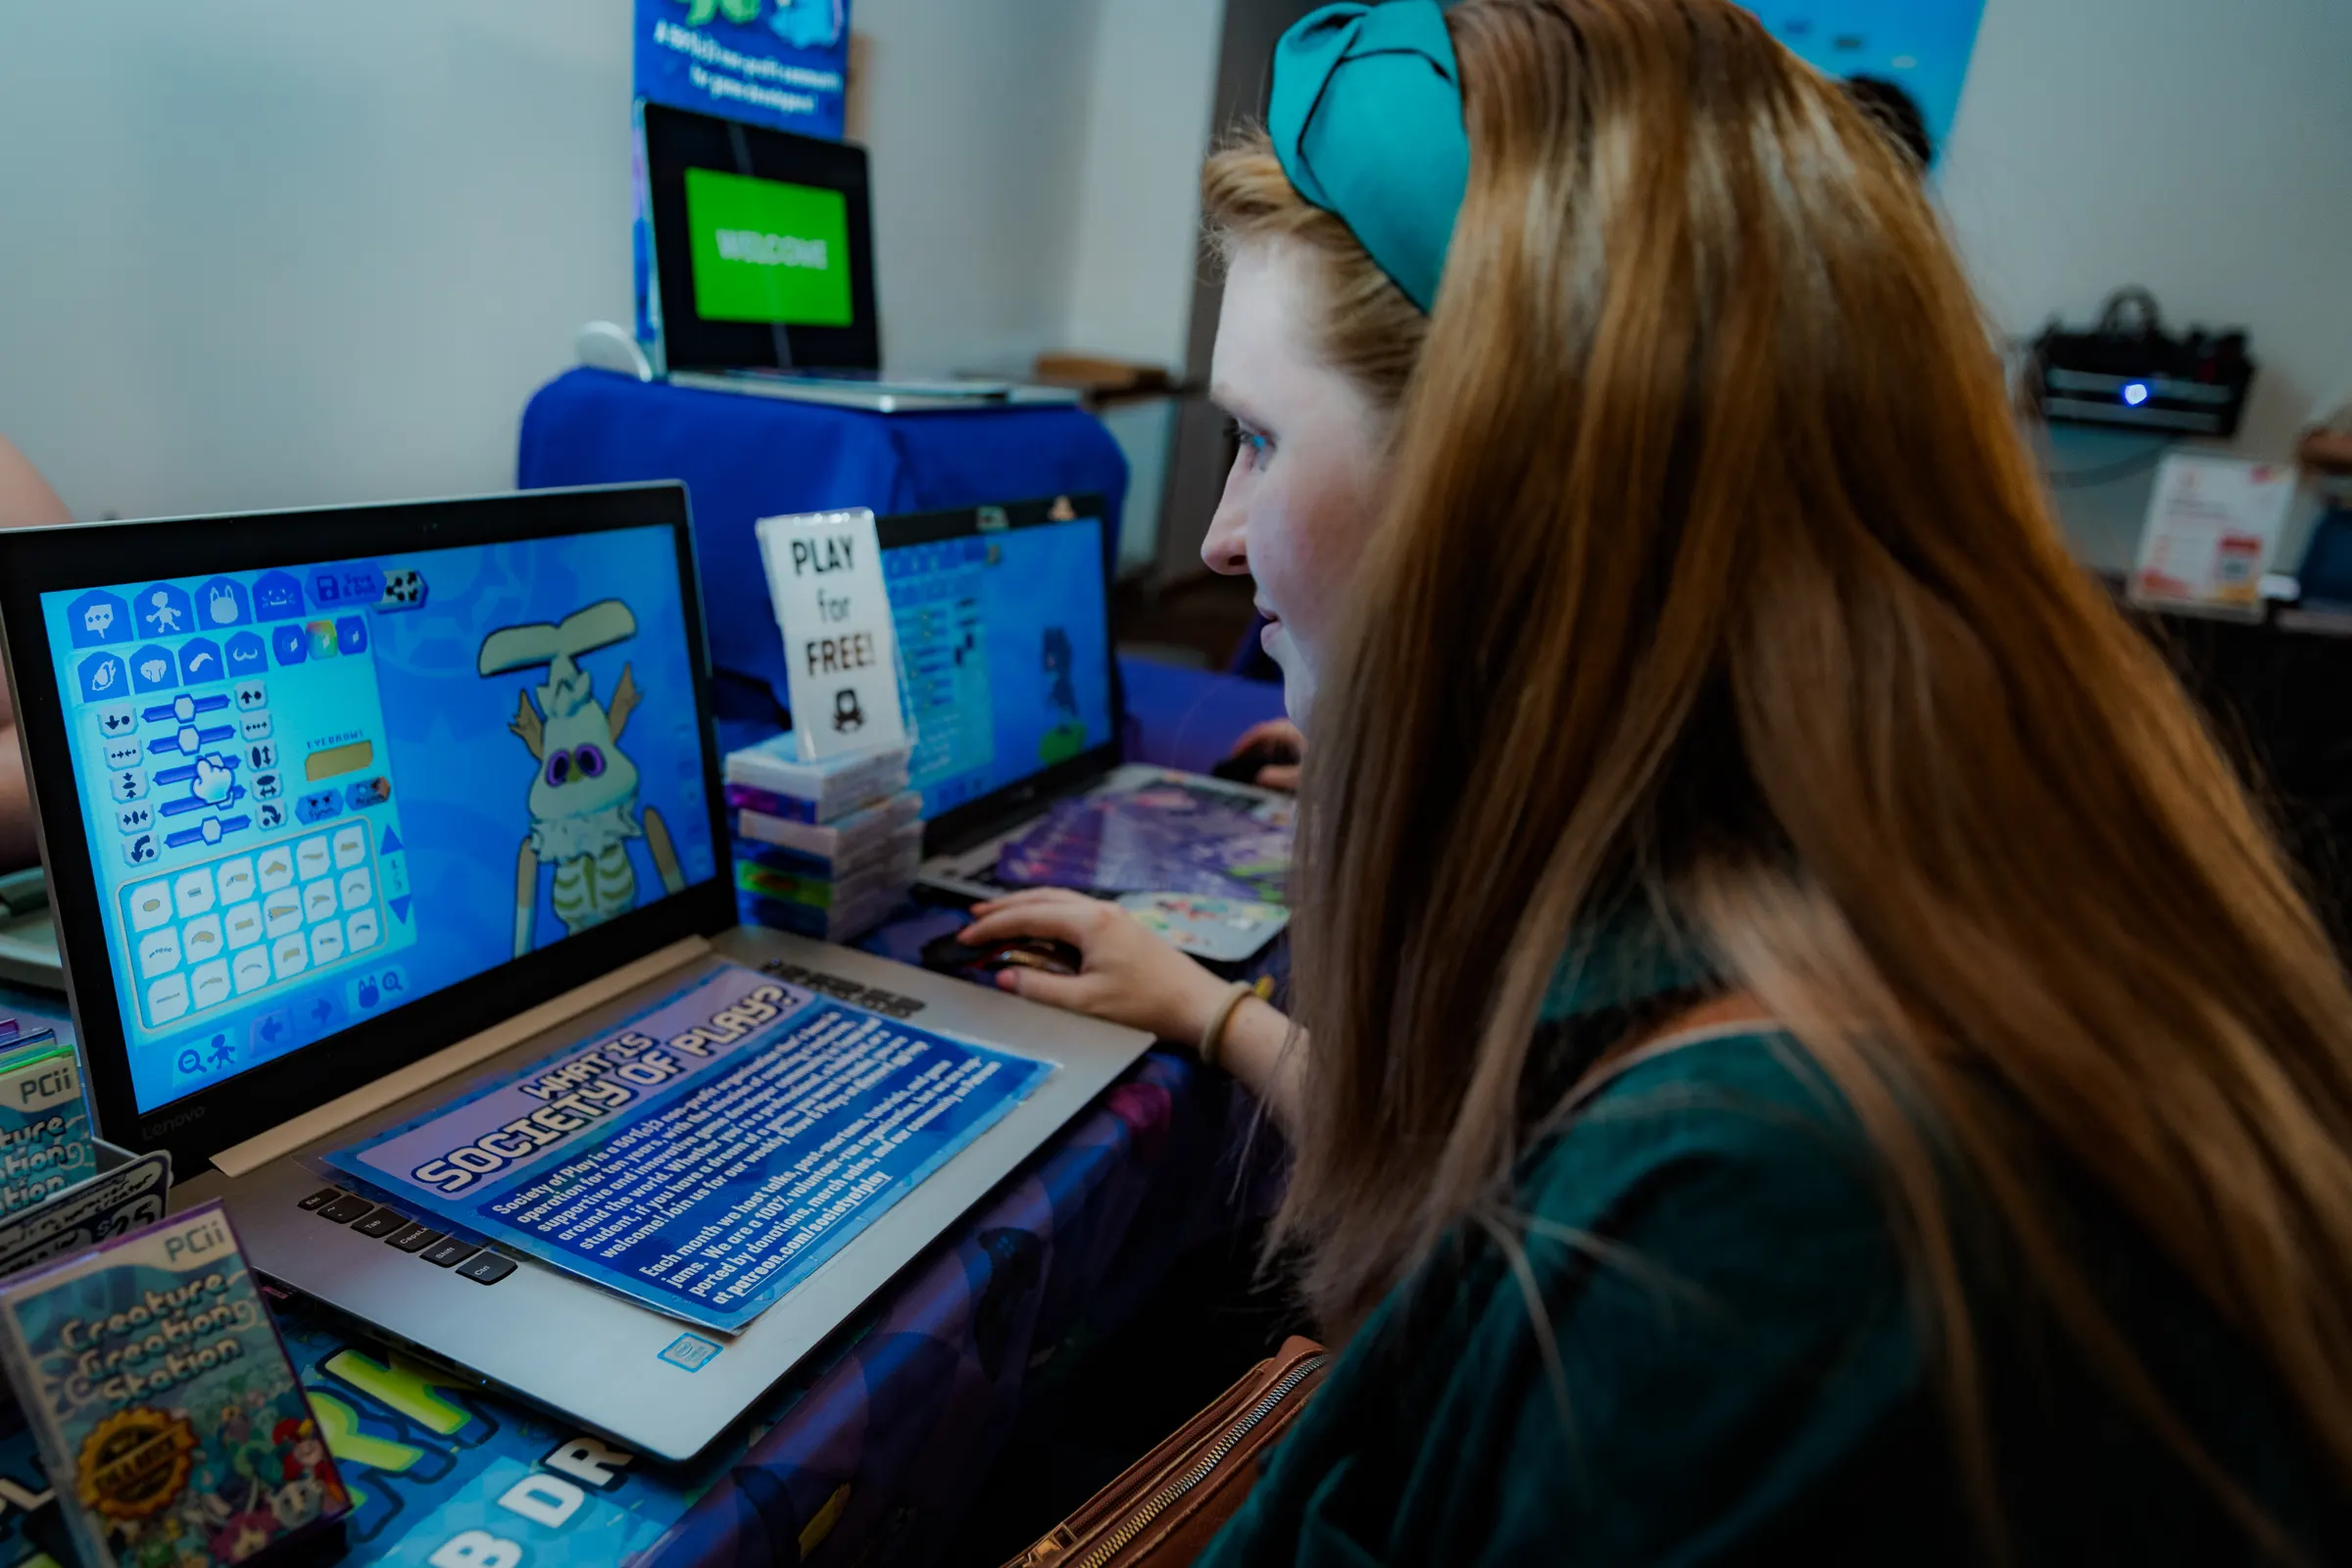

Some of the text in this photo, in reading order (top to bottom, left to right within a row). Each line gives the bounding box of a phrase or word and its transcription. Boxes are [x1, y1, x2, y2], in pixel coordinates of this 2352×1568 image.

[714, 228, 828, 270] WELCOME
[790, 535, 856, 577] PLAY
[816, 587, 852, 624] for
[806, 633, 875, 677] FREE!
[524, 1033, 652, 1100] WHAT IS
[21, 1067, 72, 1104] PCii
[416, 985, 791, 1191] SOCIETY OF PLAY?
[142, 1106, 207, 1141] Lenovo
[744, 1132, 761, 1145] of
[492, 1183, 557, 1214] Society
[548, 1173, 568, 1187] of
[559, 1158, 600, 1179] Play
[587, 1152, 611, 1162] is
[606, 1146, 620, 1154] a
[660, 1087, 721, 1123] non-profit
[706, 1142, 750, 1168] dream
[516, 1184, 588, 1224] operation
[579, 1171, 606, 1187] for
[600, 1159, 630, 1174] ten
[624, 1139, 669, 1163] years,
[661, 1121, 694, 1140] with
[537, 1188, 613, 1232] supportive
[609, 1171, 639, 1191] and
[628, 1136, 700, 1176] innovative
[694, 1116, 734, 1140] game
[664, 1171, 705, 1194] have
[699, 1165, 714, 1174] a
[786, 1144, 864, 1199] volunteer-run
[305, 1196, 321, 1206] Esc
[558, 1207, 612, 1241] around
[604, 1196, 634, 1212] the
[628, 1171, 674, 1198] world.
[662, 1139, 722, 1173] Whether
[599, 1214, 670, 1258] welcome!
[660, 1199, 696, 1219] Join
[688, 1188, 711, 1201] us
[702, 1174, 728, 1190] for
[723, 1160, 749, 1178] our
[743, 1135, 791, 1163] weekly
[645, 1191, 676, 1210] you
[754, 1195, 795, 1220] 100%
[365, 1219, 381, 1230] Tab
[629, 1203, 652, 1216] if
[638, 1253, 683, 1277] Each
[675, 1225, 724, 1256] month
[716, 1211, 742, 1227] we
[731, 1191, 769, 1214] host
[760, 1170, 803, 1194] talks,
[688, 1261, 738, 1298] ported
[726, 1251, 758, 1266] by
[745, 1206, 816, 1254] donations,
[807, 1178, 849, 1208] merch
[841, 1156, 881, 1181] sales,
[871, 1138, 897, 1158] and
[748, 1219, 763, 1228] a
[165, 1221, 226, 1262] PCii
[579, 1215, 643, 1250] student,
[700, 1243, 732, 1259] We
[711, 1170, 894, 1304] at patreon.com/societyofplay
[726, 1226, 754, 1245] are
[435, 1246, 457, 1260] Shift
[474, 1264, 490, 1277] Ctrl
[662, 1261, 710, 1290] jams.
[62, 1273, 228, 1352] Creature
[79, 1303, 241, 1381] Creation
[102, 1338, 245, 1407] Station
